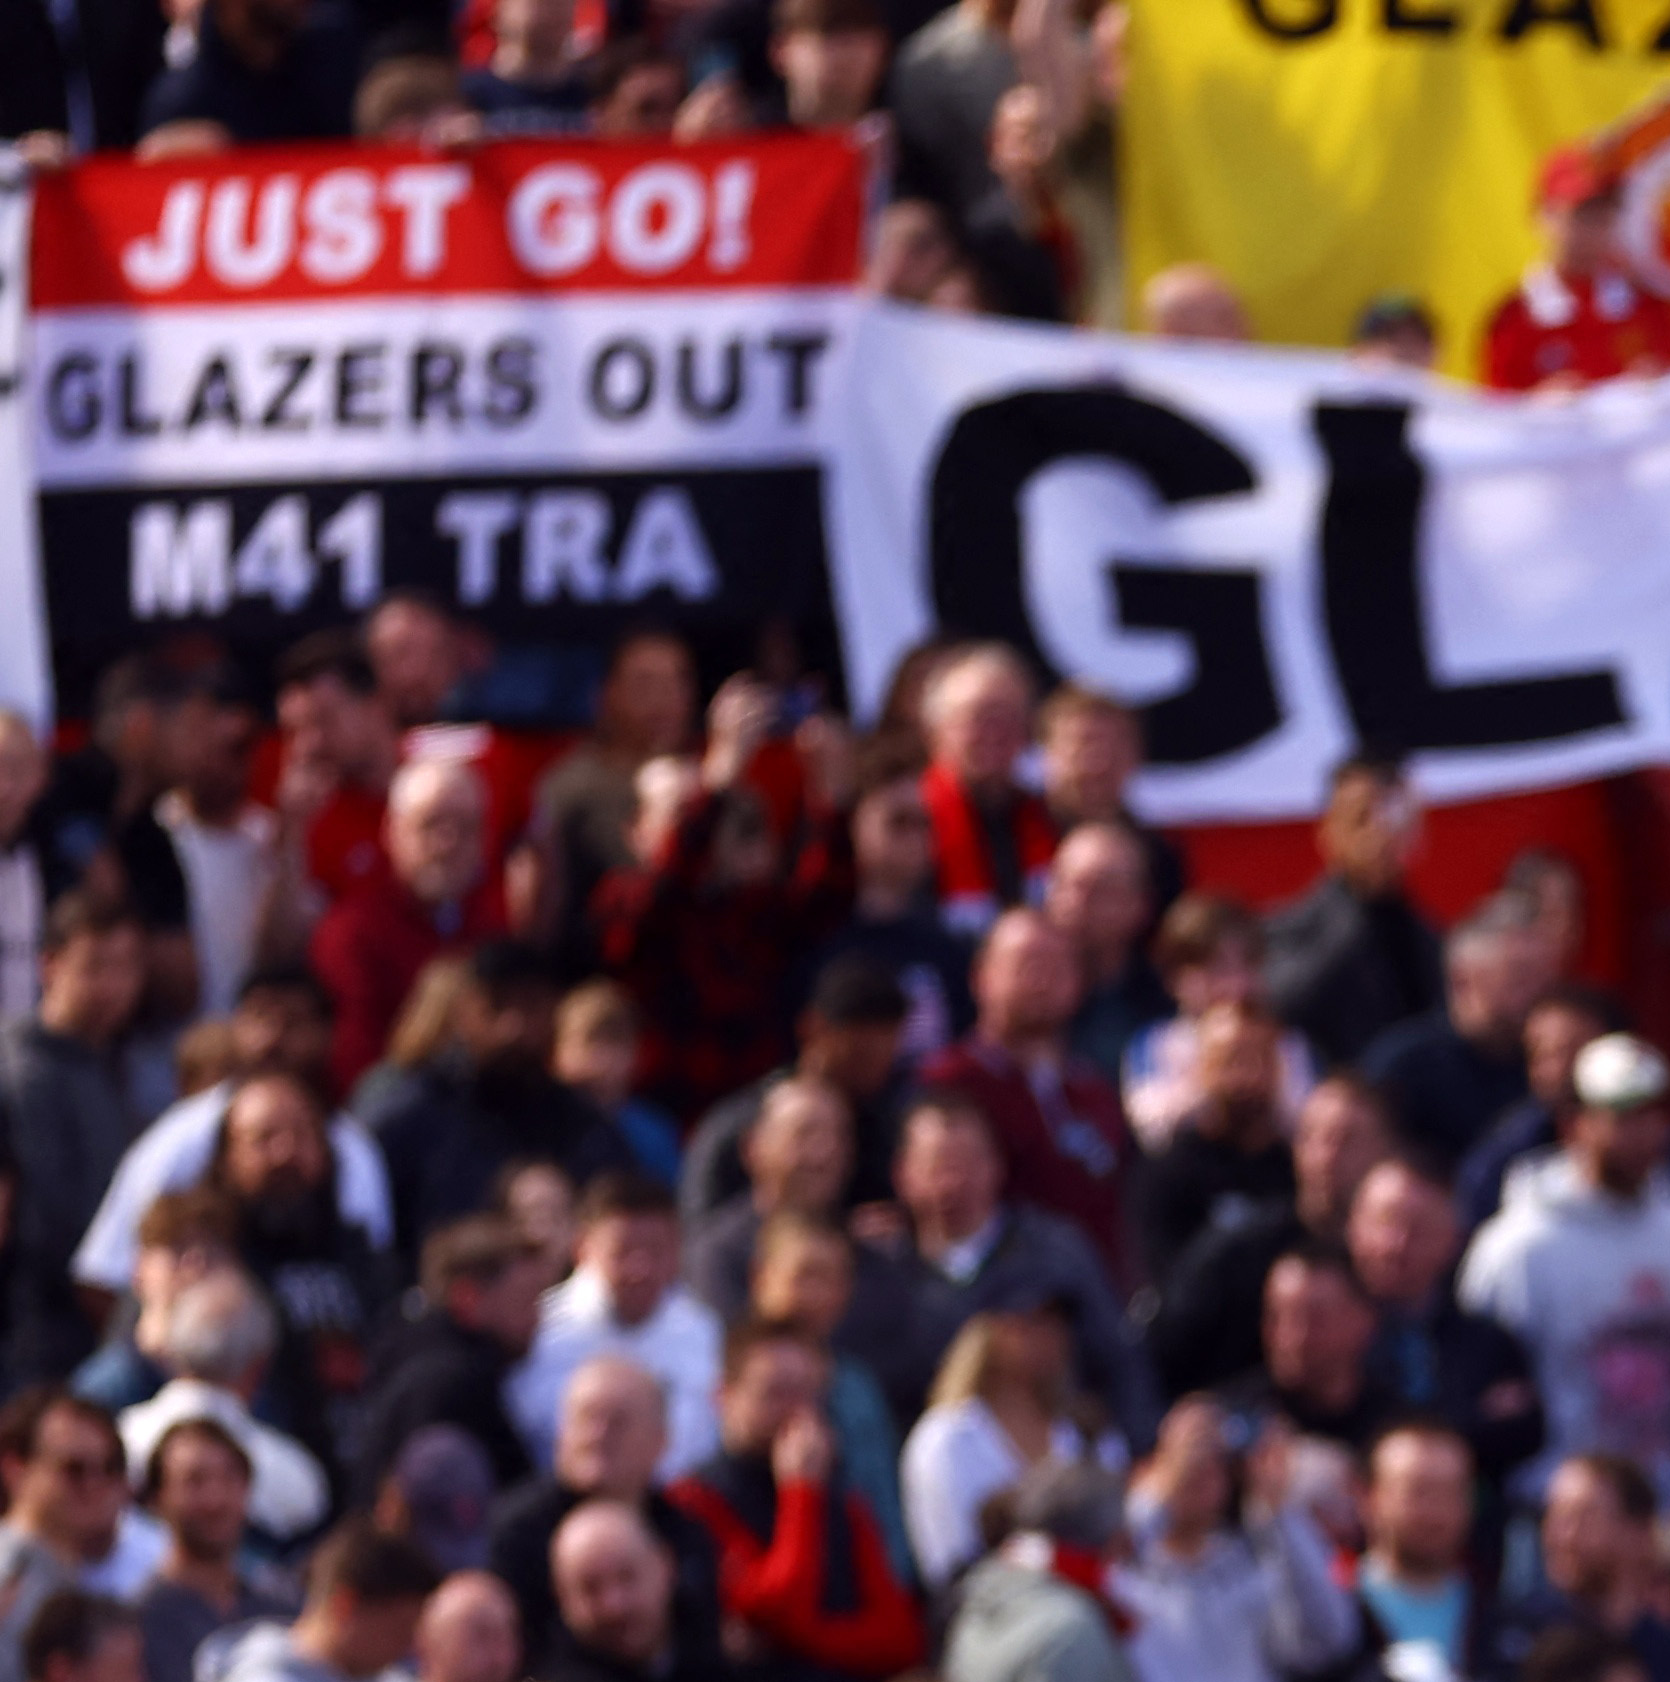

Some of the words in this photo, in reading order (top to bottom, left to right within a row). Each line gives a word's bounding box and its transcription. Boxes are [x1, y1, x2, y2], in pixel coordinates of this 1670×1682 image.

[122, 165, 468, 290] JUST
[508, 158, 758, 274] GO!
[45, 340, 540, 442] GLAZERS
[588, 330, 832, 422] OUT
[132, 492, 382, 618] M41
[438, 486, 718, 602] TRA
